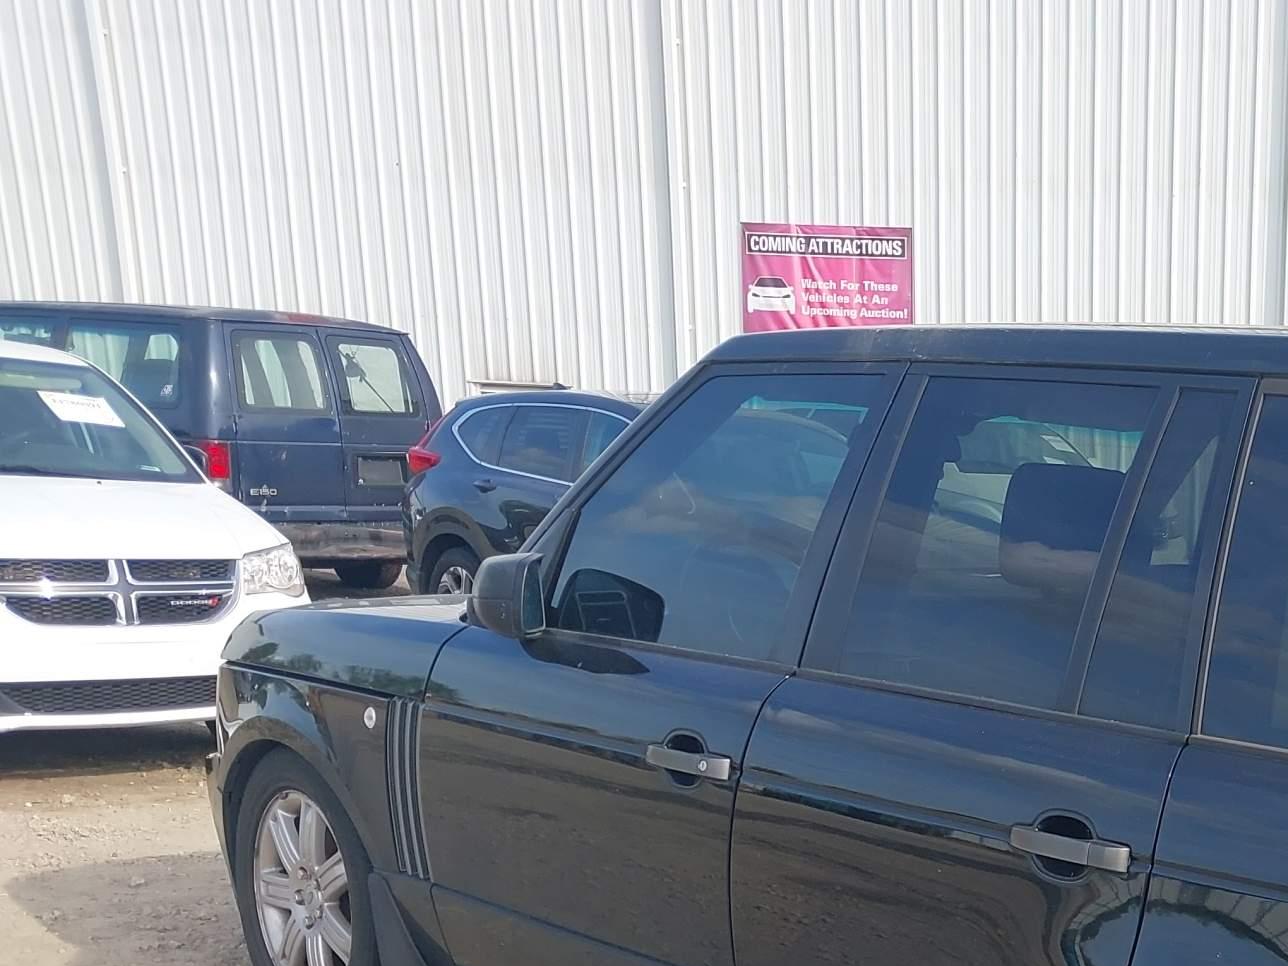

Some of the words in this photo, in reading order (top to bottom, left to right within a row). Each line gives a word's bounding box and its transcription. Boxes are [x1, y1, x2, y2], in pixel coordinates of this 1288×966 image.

[750, 235, 806, 253] COMING
[808, 238, 902, 256] ATTRACTIONS
[801, 279, 837, 290] Watch
[840, 280, 860, 291] For
[863, 281, 899, 292] These
[801, 292, 850, 304] Vehicles
[853, 294, 868, 305] At
[871, 295, 889, 305] An
[801, 306, 858, 320] Upcoming
[860, 307, 908, 319] Auction!
